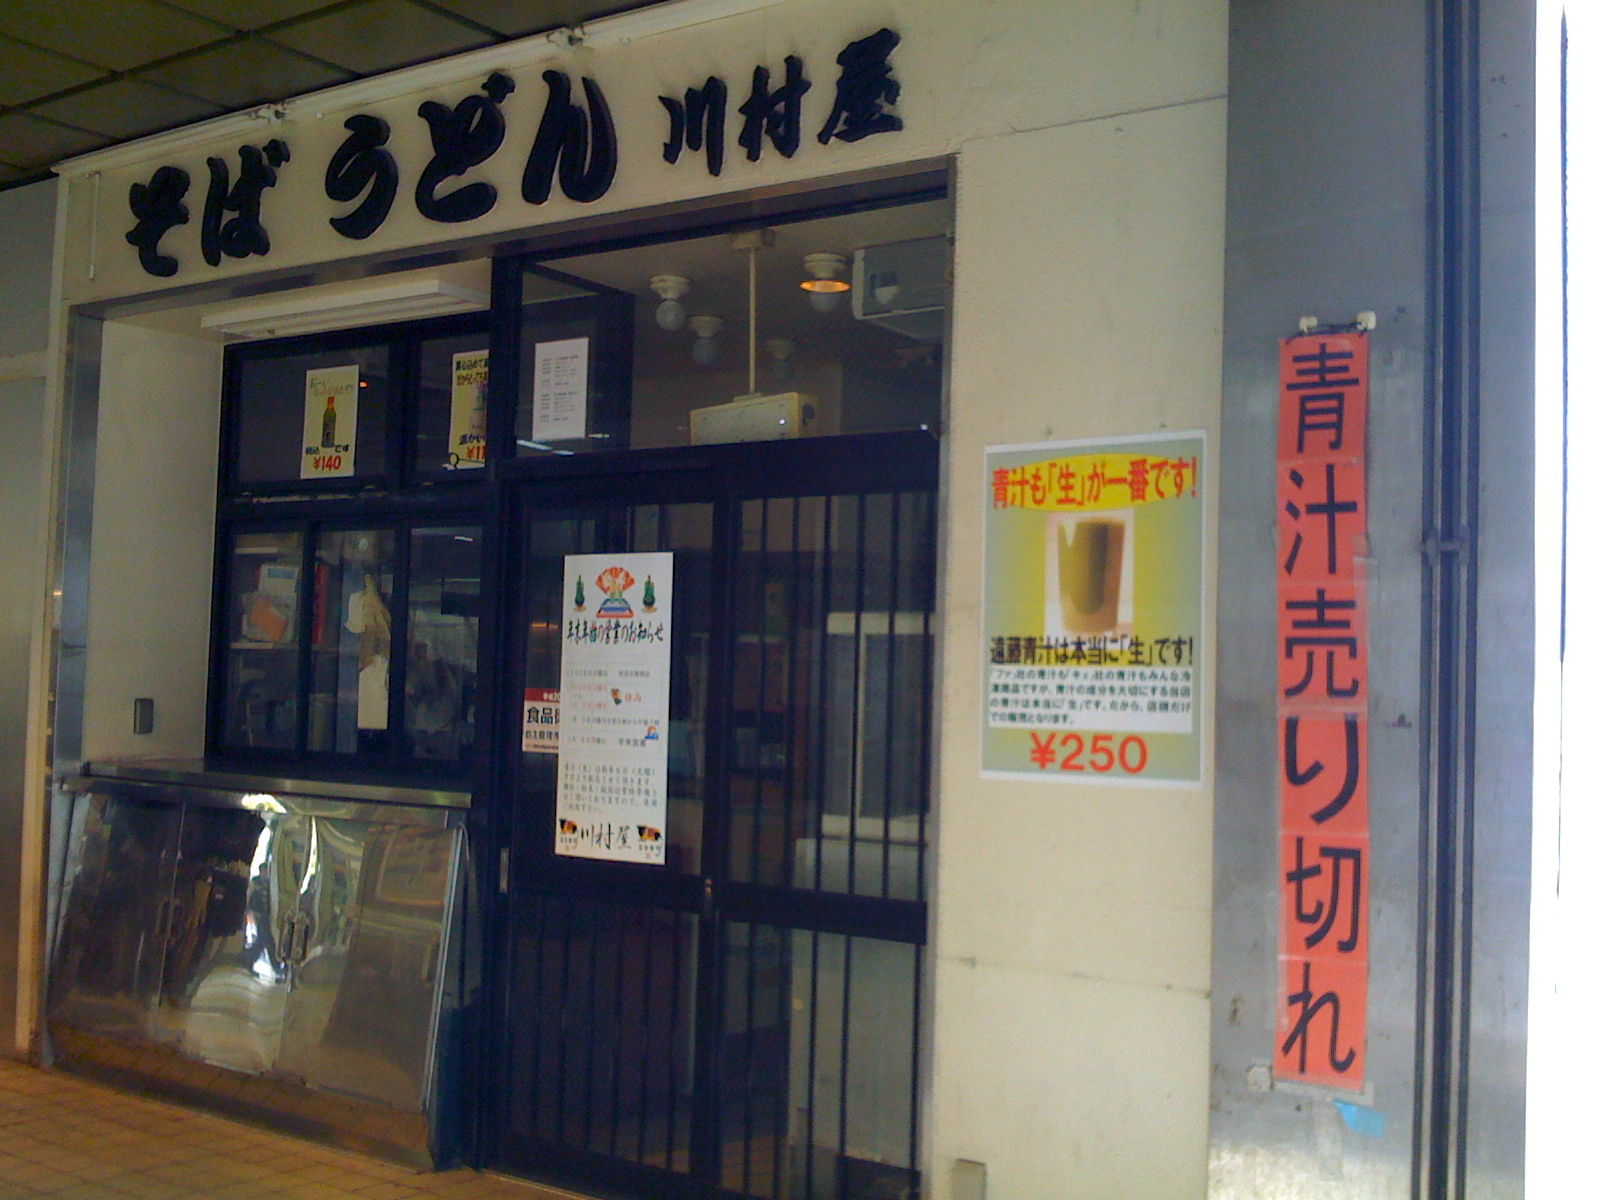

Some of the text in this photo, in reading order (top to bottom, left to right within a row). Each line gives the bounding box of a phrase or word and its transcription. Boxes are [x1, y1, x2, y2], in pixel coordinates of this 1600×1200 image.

[125, 28, 904, 277] そば うどん 川村屋
[313, 456, 342, 471] ¥140
[991, 456, 1198, 510] 青汁も「生」が一番です!
[989, 635, 1194, 665] 遠藤青汁は本当に「生」です!
[1281, 342, 1361, 1075] 青汁売り切れ
[1030, 731, 1148, 775] ¥250
[581, 822, 632, 852] 川村屋
